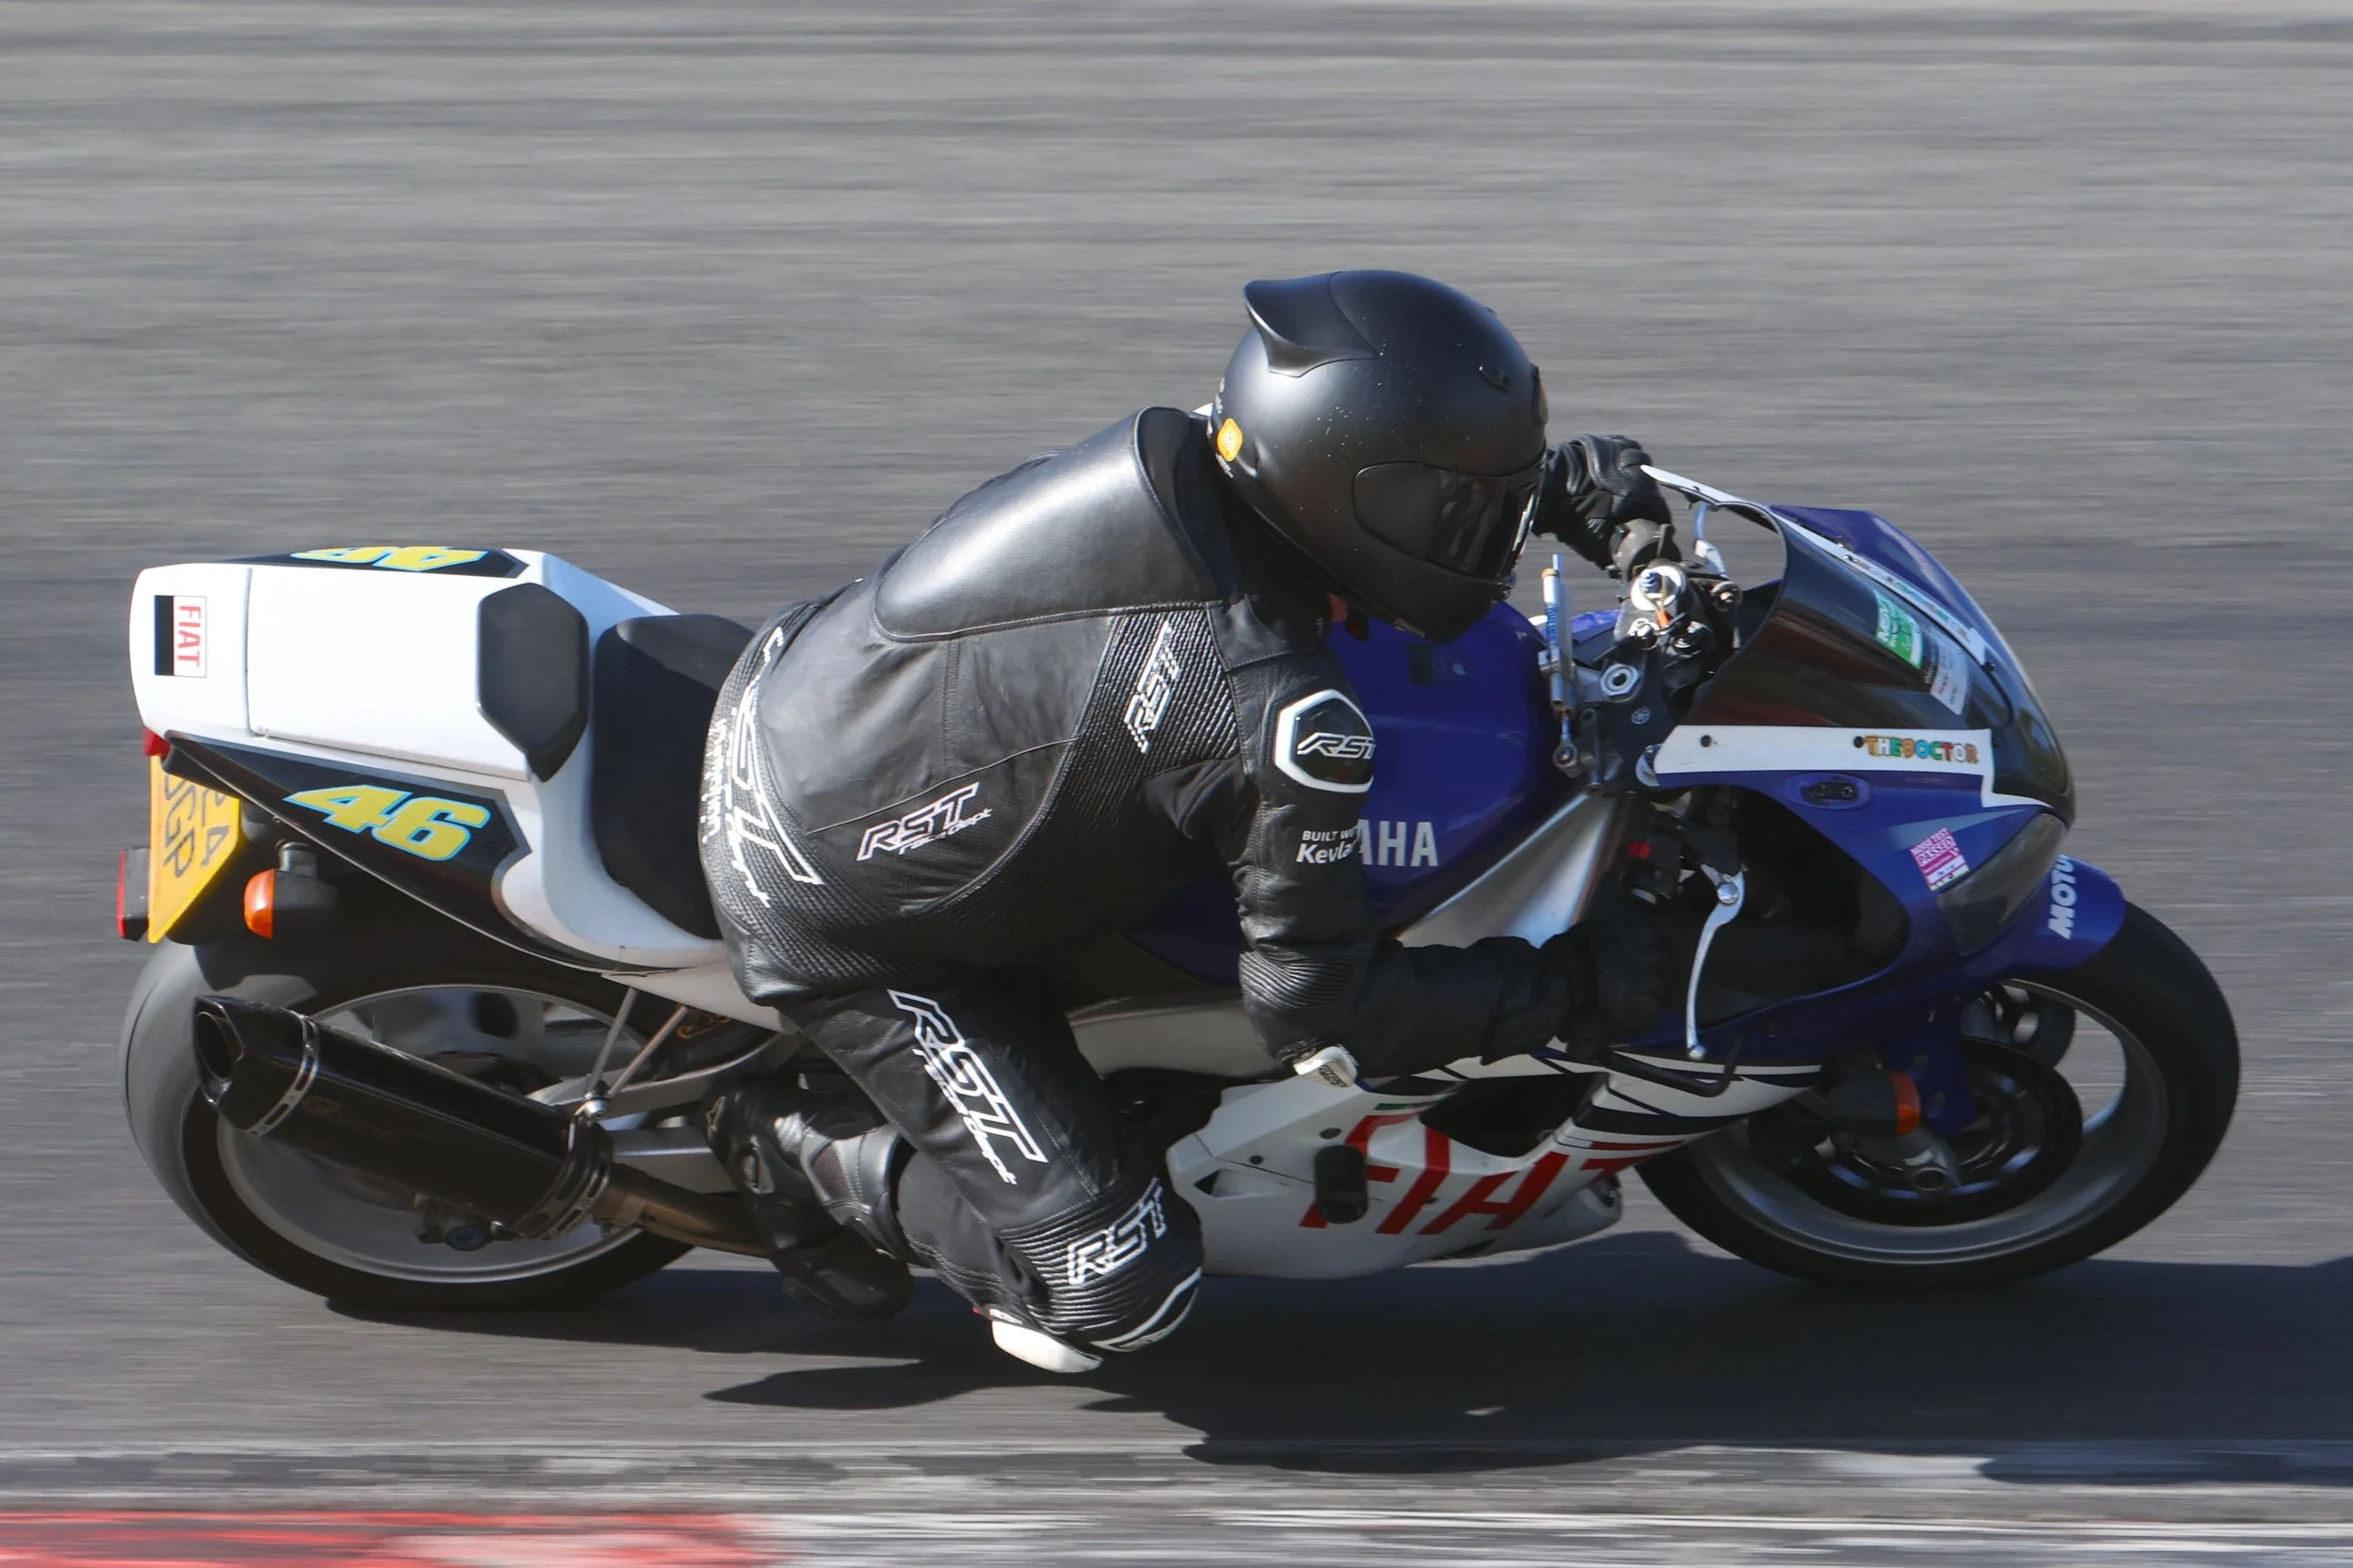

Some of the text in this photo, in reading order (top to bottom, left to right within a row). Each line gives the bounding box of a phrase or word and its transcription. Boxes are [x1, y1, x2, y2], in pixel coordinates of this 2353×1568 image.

[177, 605, 201, 667] FIAT
[284, 784, 490, 861] 46
[856, 782, 980, 861] RST
[1296, 840, 1353, 863] Kevla
[1302, 830, 1338, 841] BUILT
[887, 988, 1048, 1162] RST
[1067, 1175, 1167, 1285] RST
